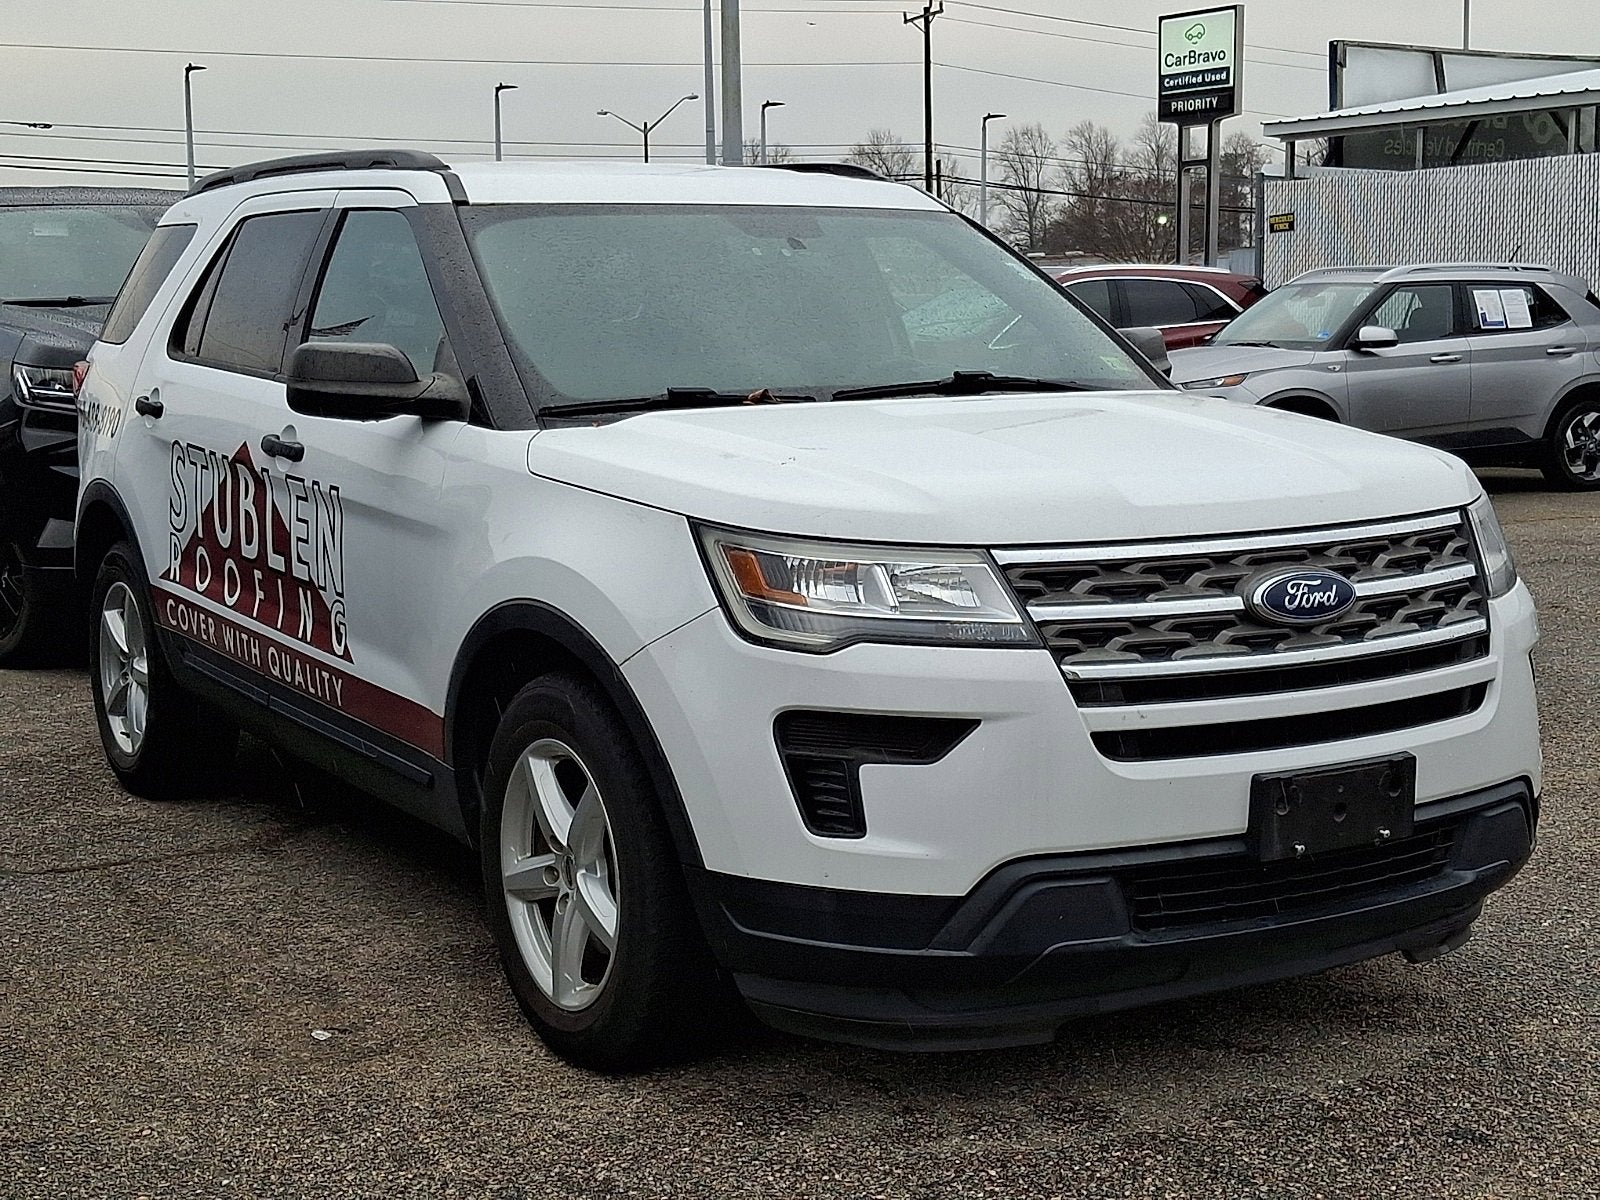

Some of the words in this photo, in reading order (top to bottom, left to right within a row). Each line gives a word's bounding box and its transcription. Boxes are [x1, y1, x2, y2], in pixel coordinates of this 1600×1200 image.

[1164, 49, 1226, 68] CarBravo
[1164, 74, 1202, 87] Certified
[1204, 71, 1227, 82] Used
[1171, 96, 1218, 112] PRIORITY
[169, 440, 345, 598] STUBLEN
[169, 532, 347, 656] ROOFING
[1284, 579, 1338, 610] Ford
[166, 598, 217, 646] COVER
[222, 624, 261, 668] WITH
[267, 646, 343, 707] QUALITY
